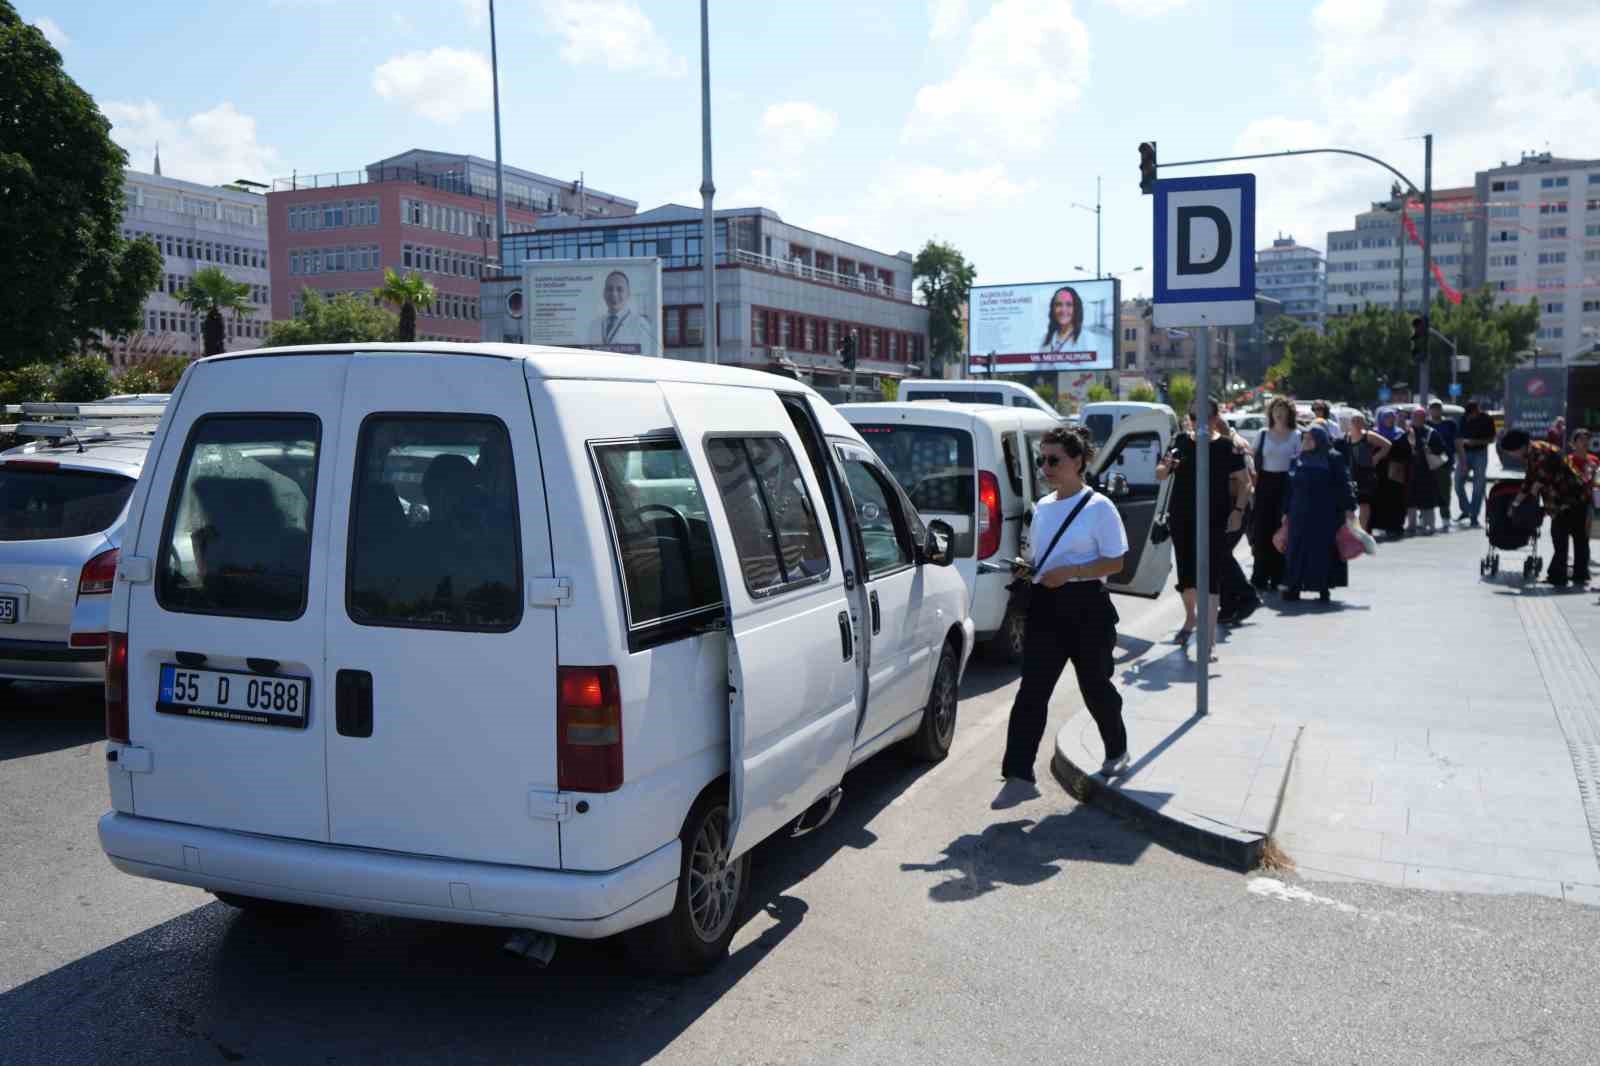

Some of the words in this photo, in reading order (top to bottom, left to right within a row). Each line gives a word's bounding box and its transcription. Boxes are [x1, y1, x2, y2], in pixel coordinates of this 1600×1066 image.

[1176, 205, 1233, 276] D
[175, 672, 200, 702] 55
[217, 676, 229, 705] D
[247, 679, 299, 712] 0588
